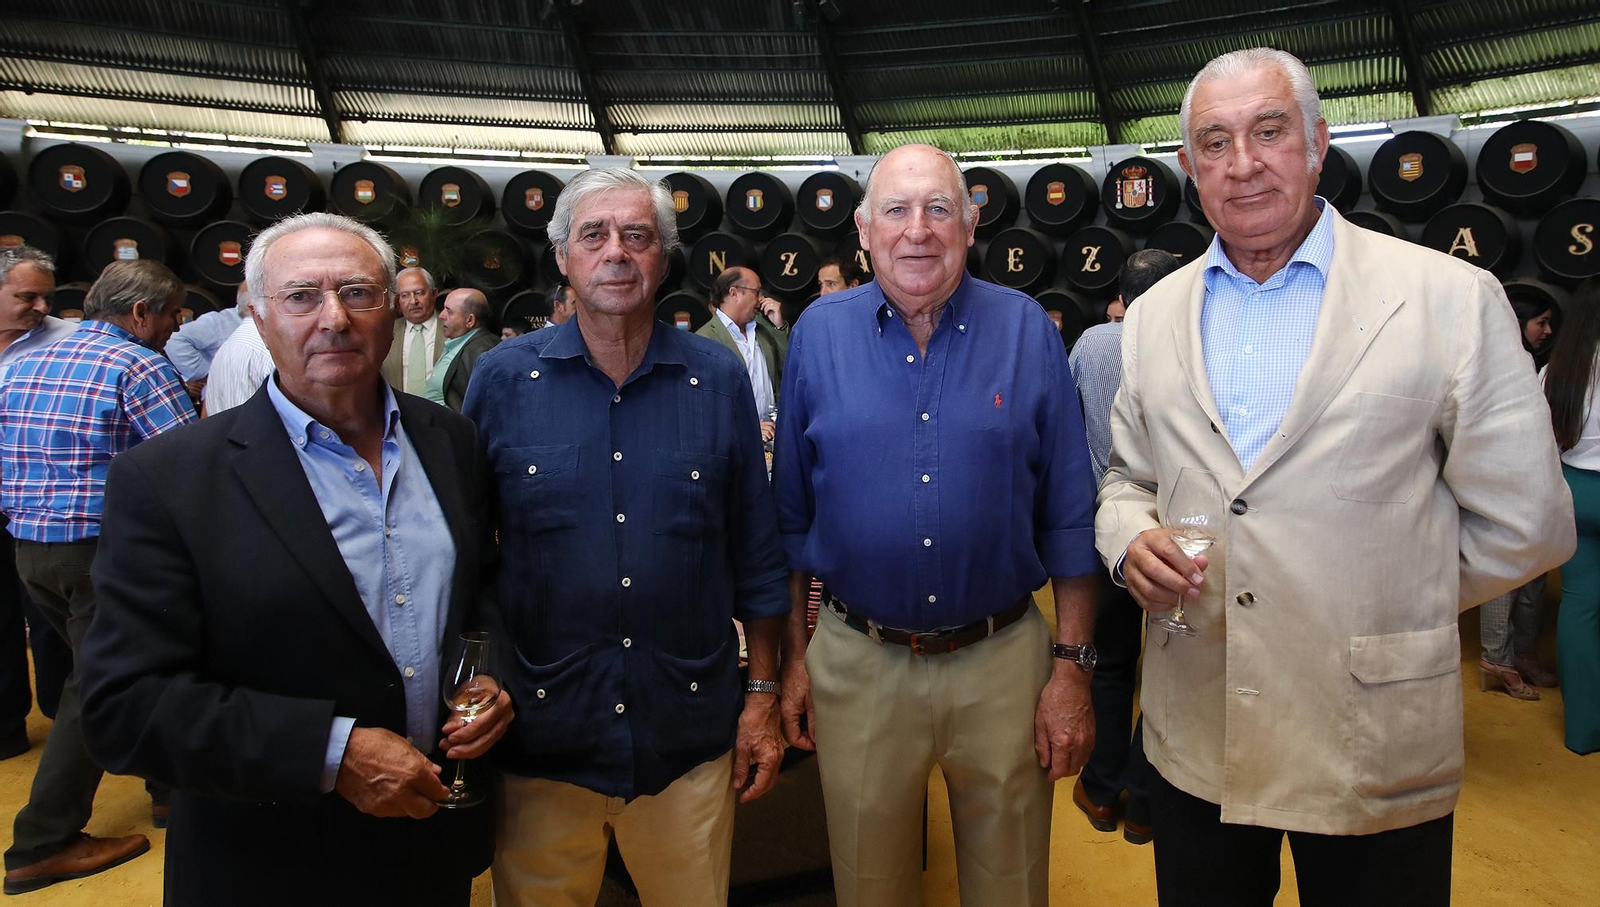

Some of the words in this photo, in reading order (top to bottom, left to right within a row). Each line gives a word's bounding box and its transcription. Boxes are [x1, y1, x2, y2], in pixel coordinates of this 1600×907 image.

[708, 249, 727, 275] N
[779, 251, 800, 277] Z
[1006, 247, 1025, 273] E
[1080, 245, 1102, 273] Z
[1448, 226, 1480, 257] A
[1567, 222, 1595, 256] S
